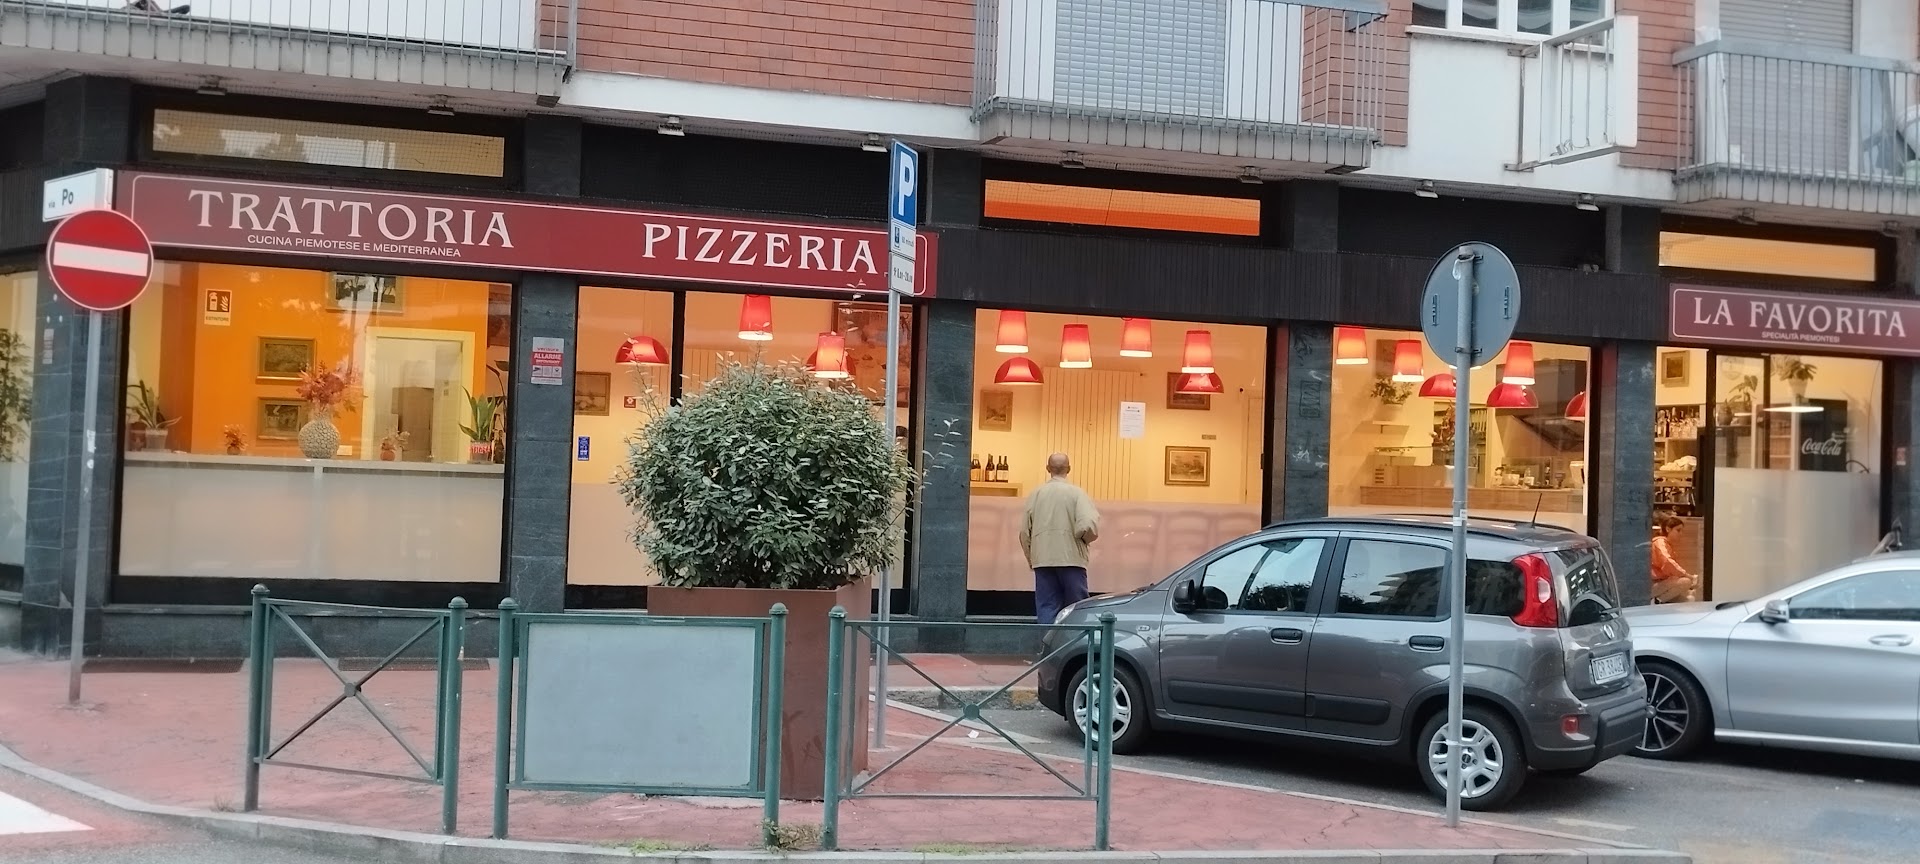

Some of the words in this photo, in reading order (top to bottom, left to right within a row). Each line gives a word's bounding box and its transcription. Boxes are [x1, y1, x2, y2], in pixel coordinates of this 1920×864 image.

[62, 188, 74, 206] Po
[898, 150, 915, 217] P
[188, 189, 514, 249] TRATTORIA
[247, 234, 293, 247] CUCINA
[295, 237, 361, 251] PIEMOTESE
[363, 242, 371, 251] E
[373, 243, 462, 258] MEDITERRANEA
[642, 222, 878, 275] PIZZERIA
[1693, 297, 1735, 327] LA
[1749, 301, 1907, 338] FAVORITA
[1761, 331, 1799, 340] SPECIALITÀ
[1799, 333, 1841, 343] PIEMONTESI
